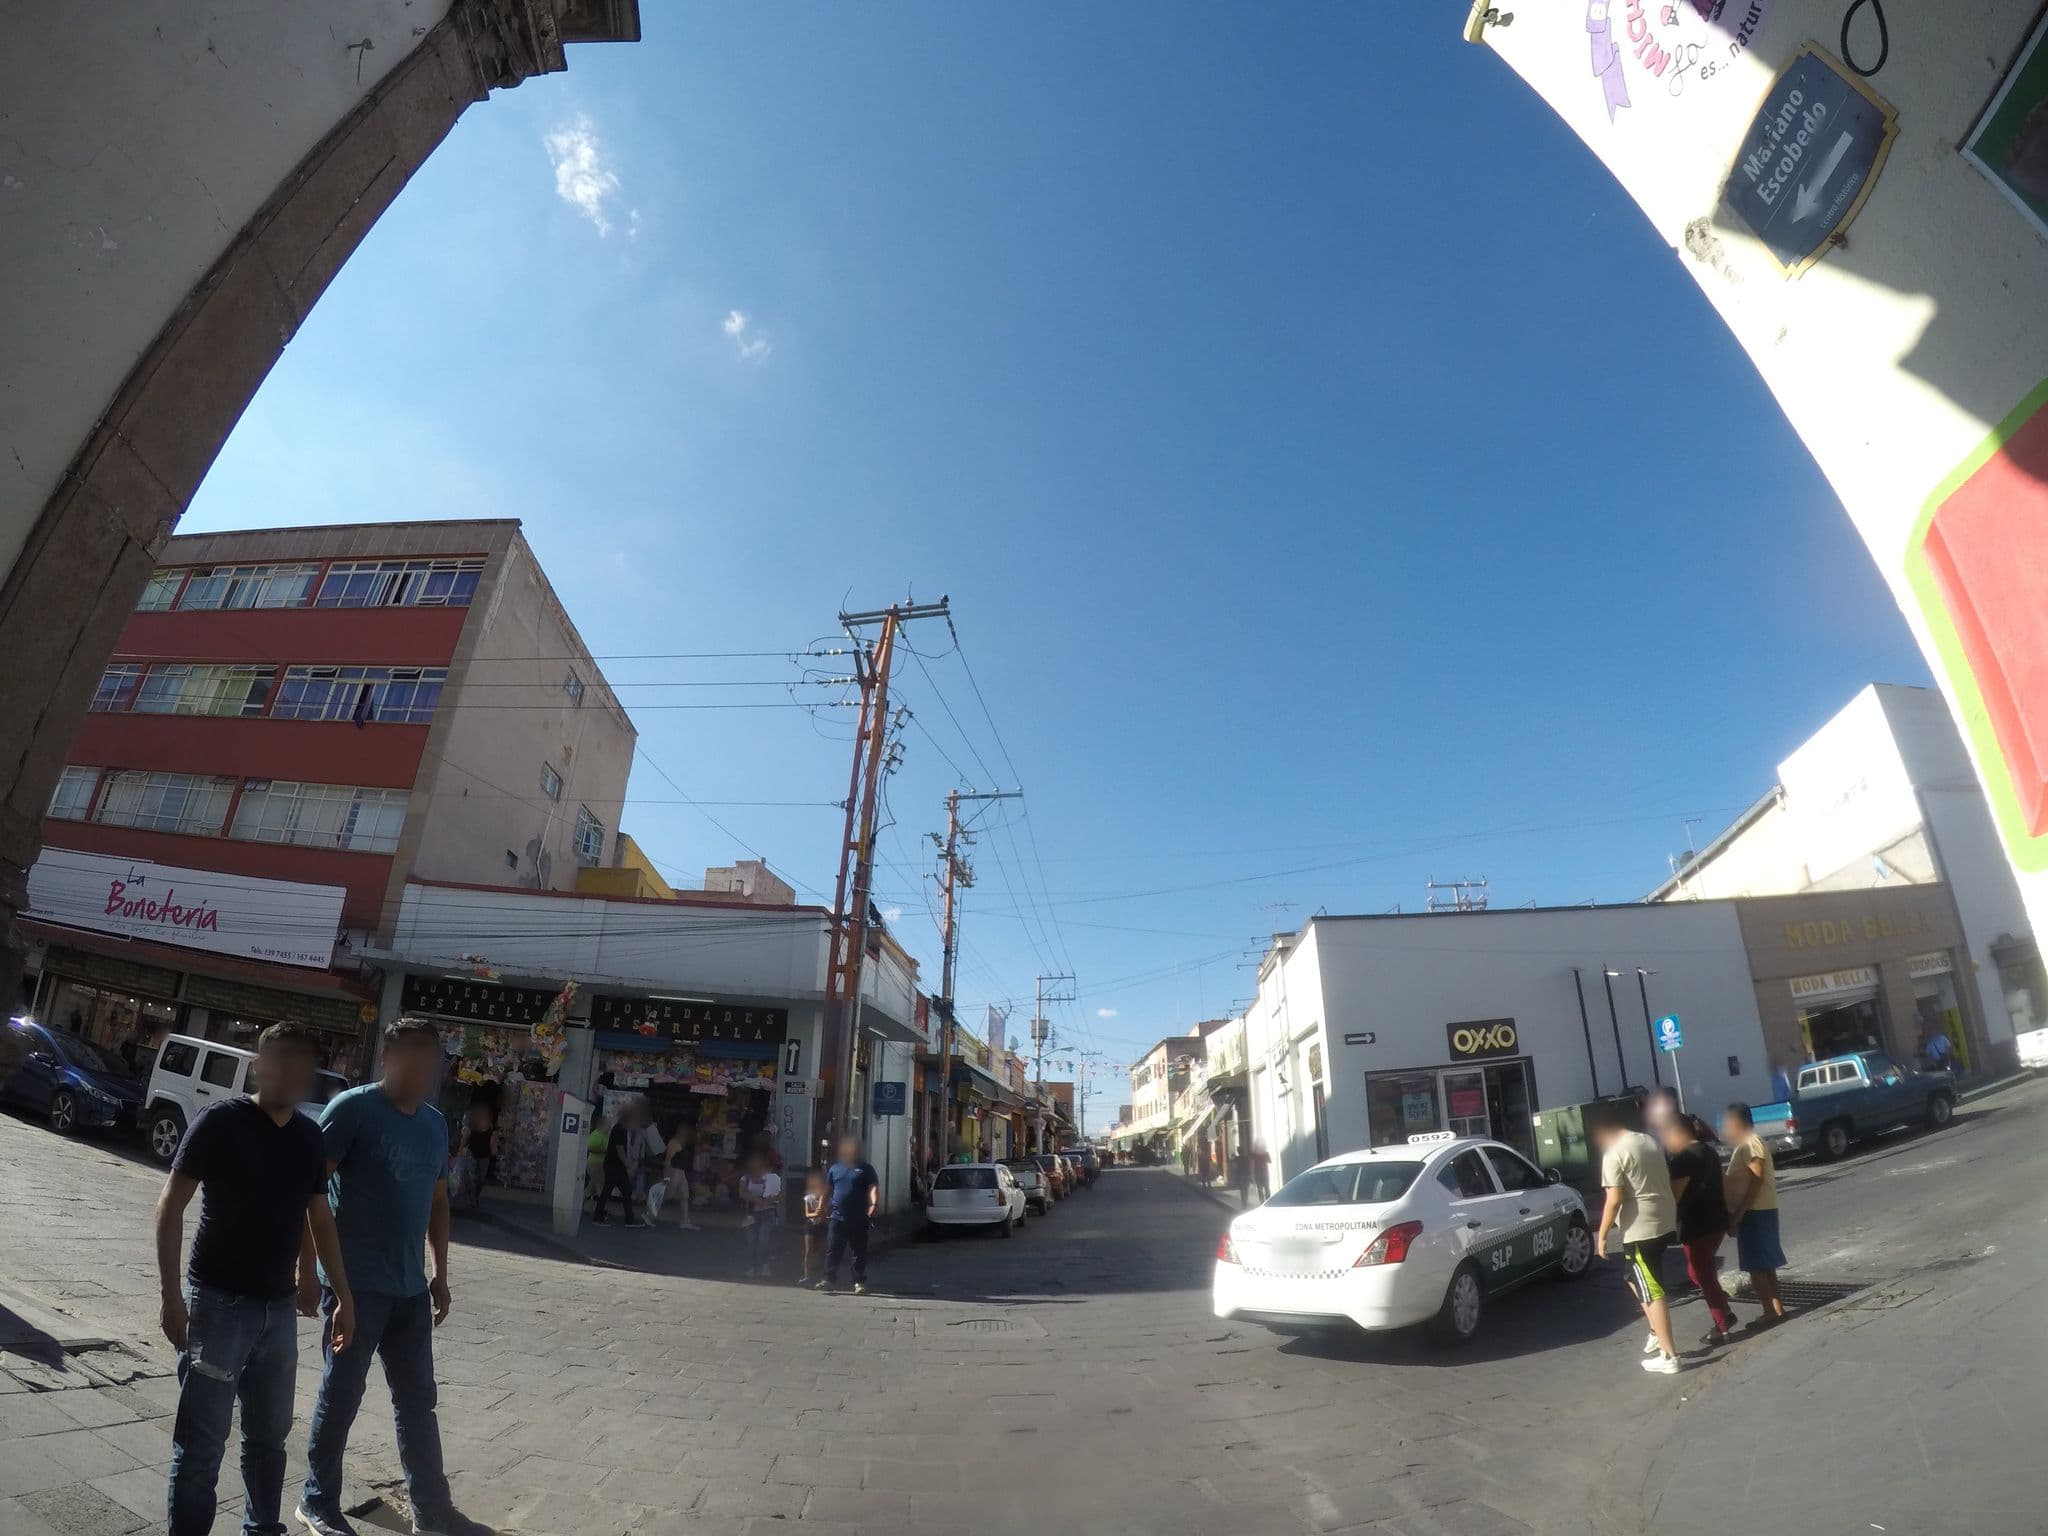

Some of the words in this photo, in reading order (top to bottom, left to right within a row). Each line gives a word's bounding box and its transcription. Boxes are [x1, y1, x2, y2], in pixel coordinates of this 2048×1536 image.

[1743, 89, 1803, 182] Mariano
[1756, 103, 1826, 205] Escobedo
[126, 866, 145, 887] La
[104, 879, 218, 932] Bonetería
[1784, 919, 1855, 949] MODA
[413, 982, 542, 1006] NOVEDADE
[419, 995, 531, 1020] ESTRELL
[604, 1002, 774, 1025] NOVEDADES
[1453, 1023, 1516, 1054] OXXO
[565, 1116, 577, 1130] P
[1411, 1132, 1451, 1143] 0592
[1295, 1222, 1313, 1231] ZONA
[1315, 1221, 1377, 1231] METROPOLITANA
[1533, 1226, 1553, 1257] 0592
[1491, 1245, 1513, 1272] SLP
